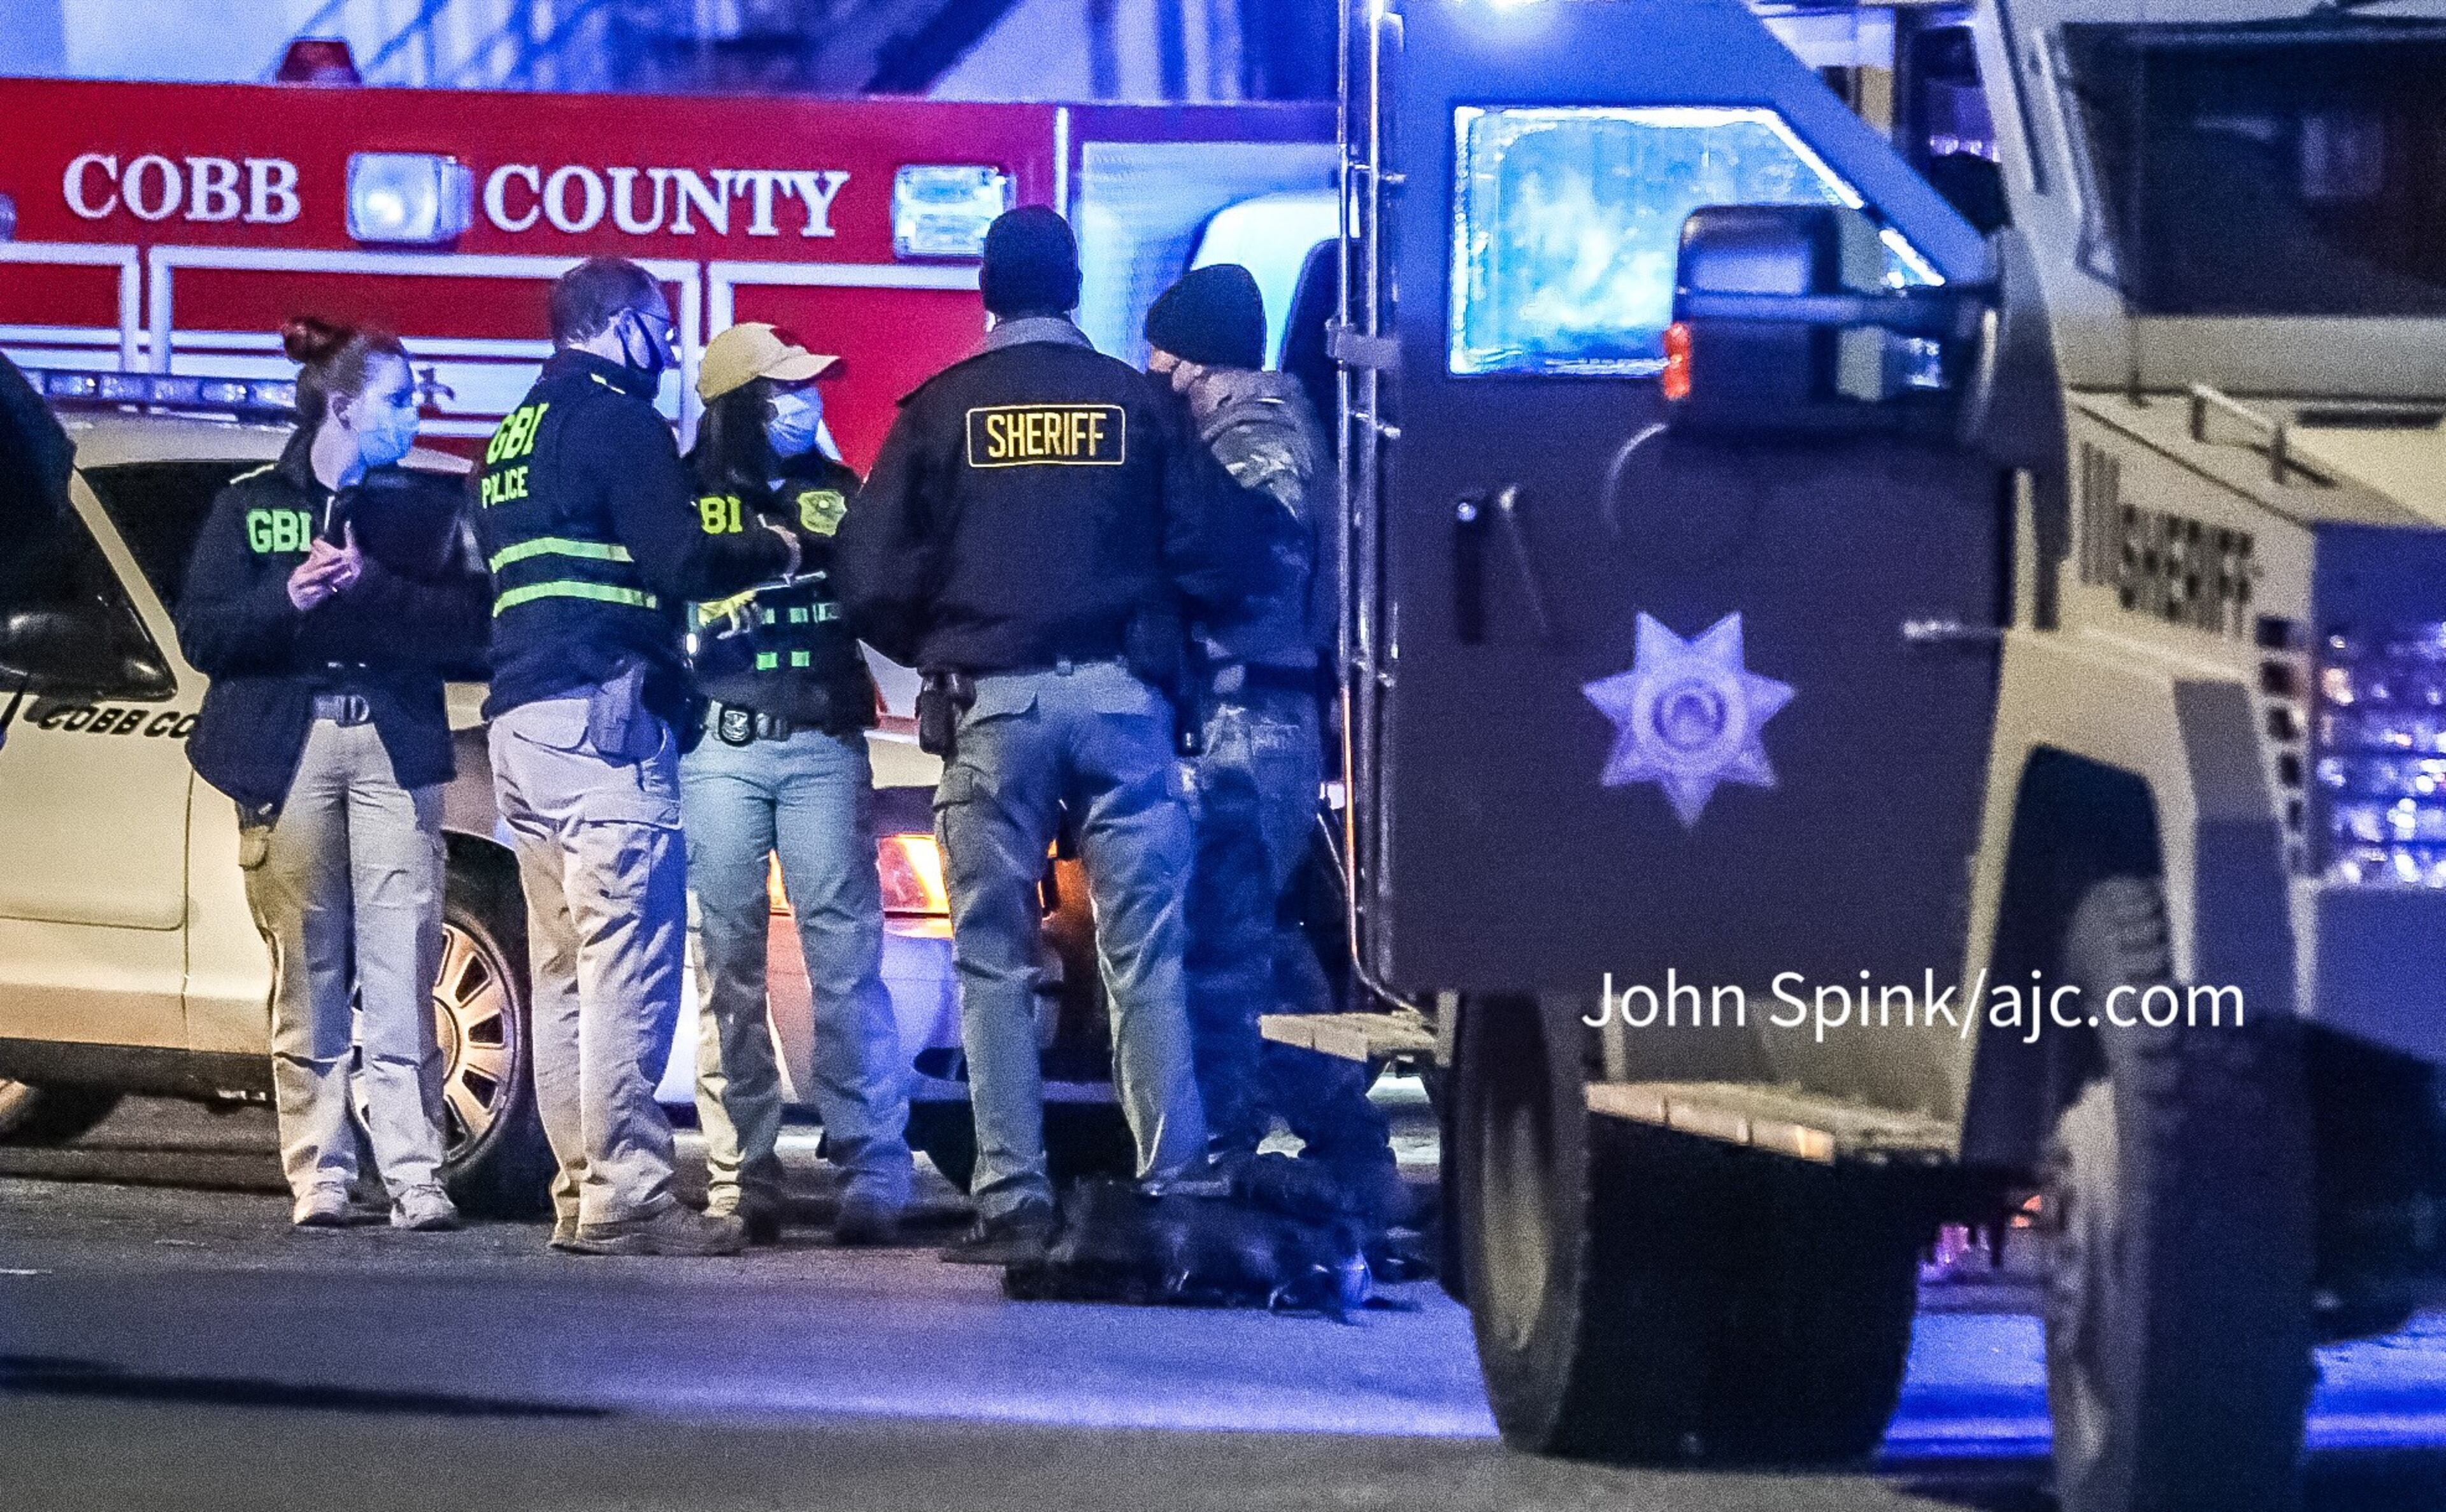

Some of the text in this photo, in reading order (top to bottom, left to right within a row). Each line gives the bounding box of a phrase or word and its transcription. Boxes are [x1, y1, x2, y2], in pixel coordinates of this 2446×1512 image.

[63, 153, 301, 223] COBB
[483, 164, 850, 238] COUNTY
[486, 402, 550, 465] GBI
[987, 411, 1107, 458] SHERIFF
[247, 508, 311, 553] GBI
[699, 496, 743, 534] BI
[39, 706, 150, 735] COBB
